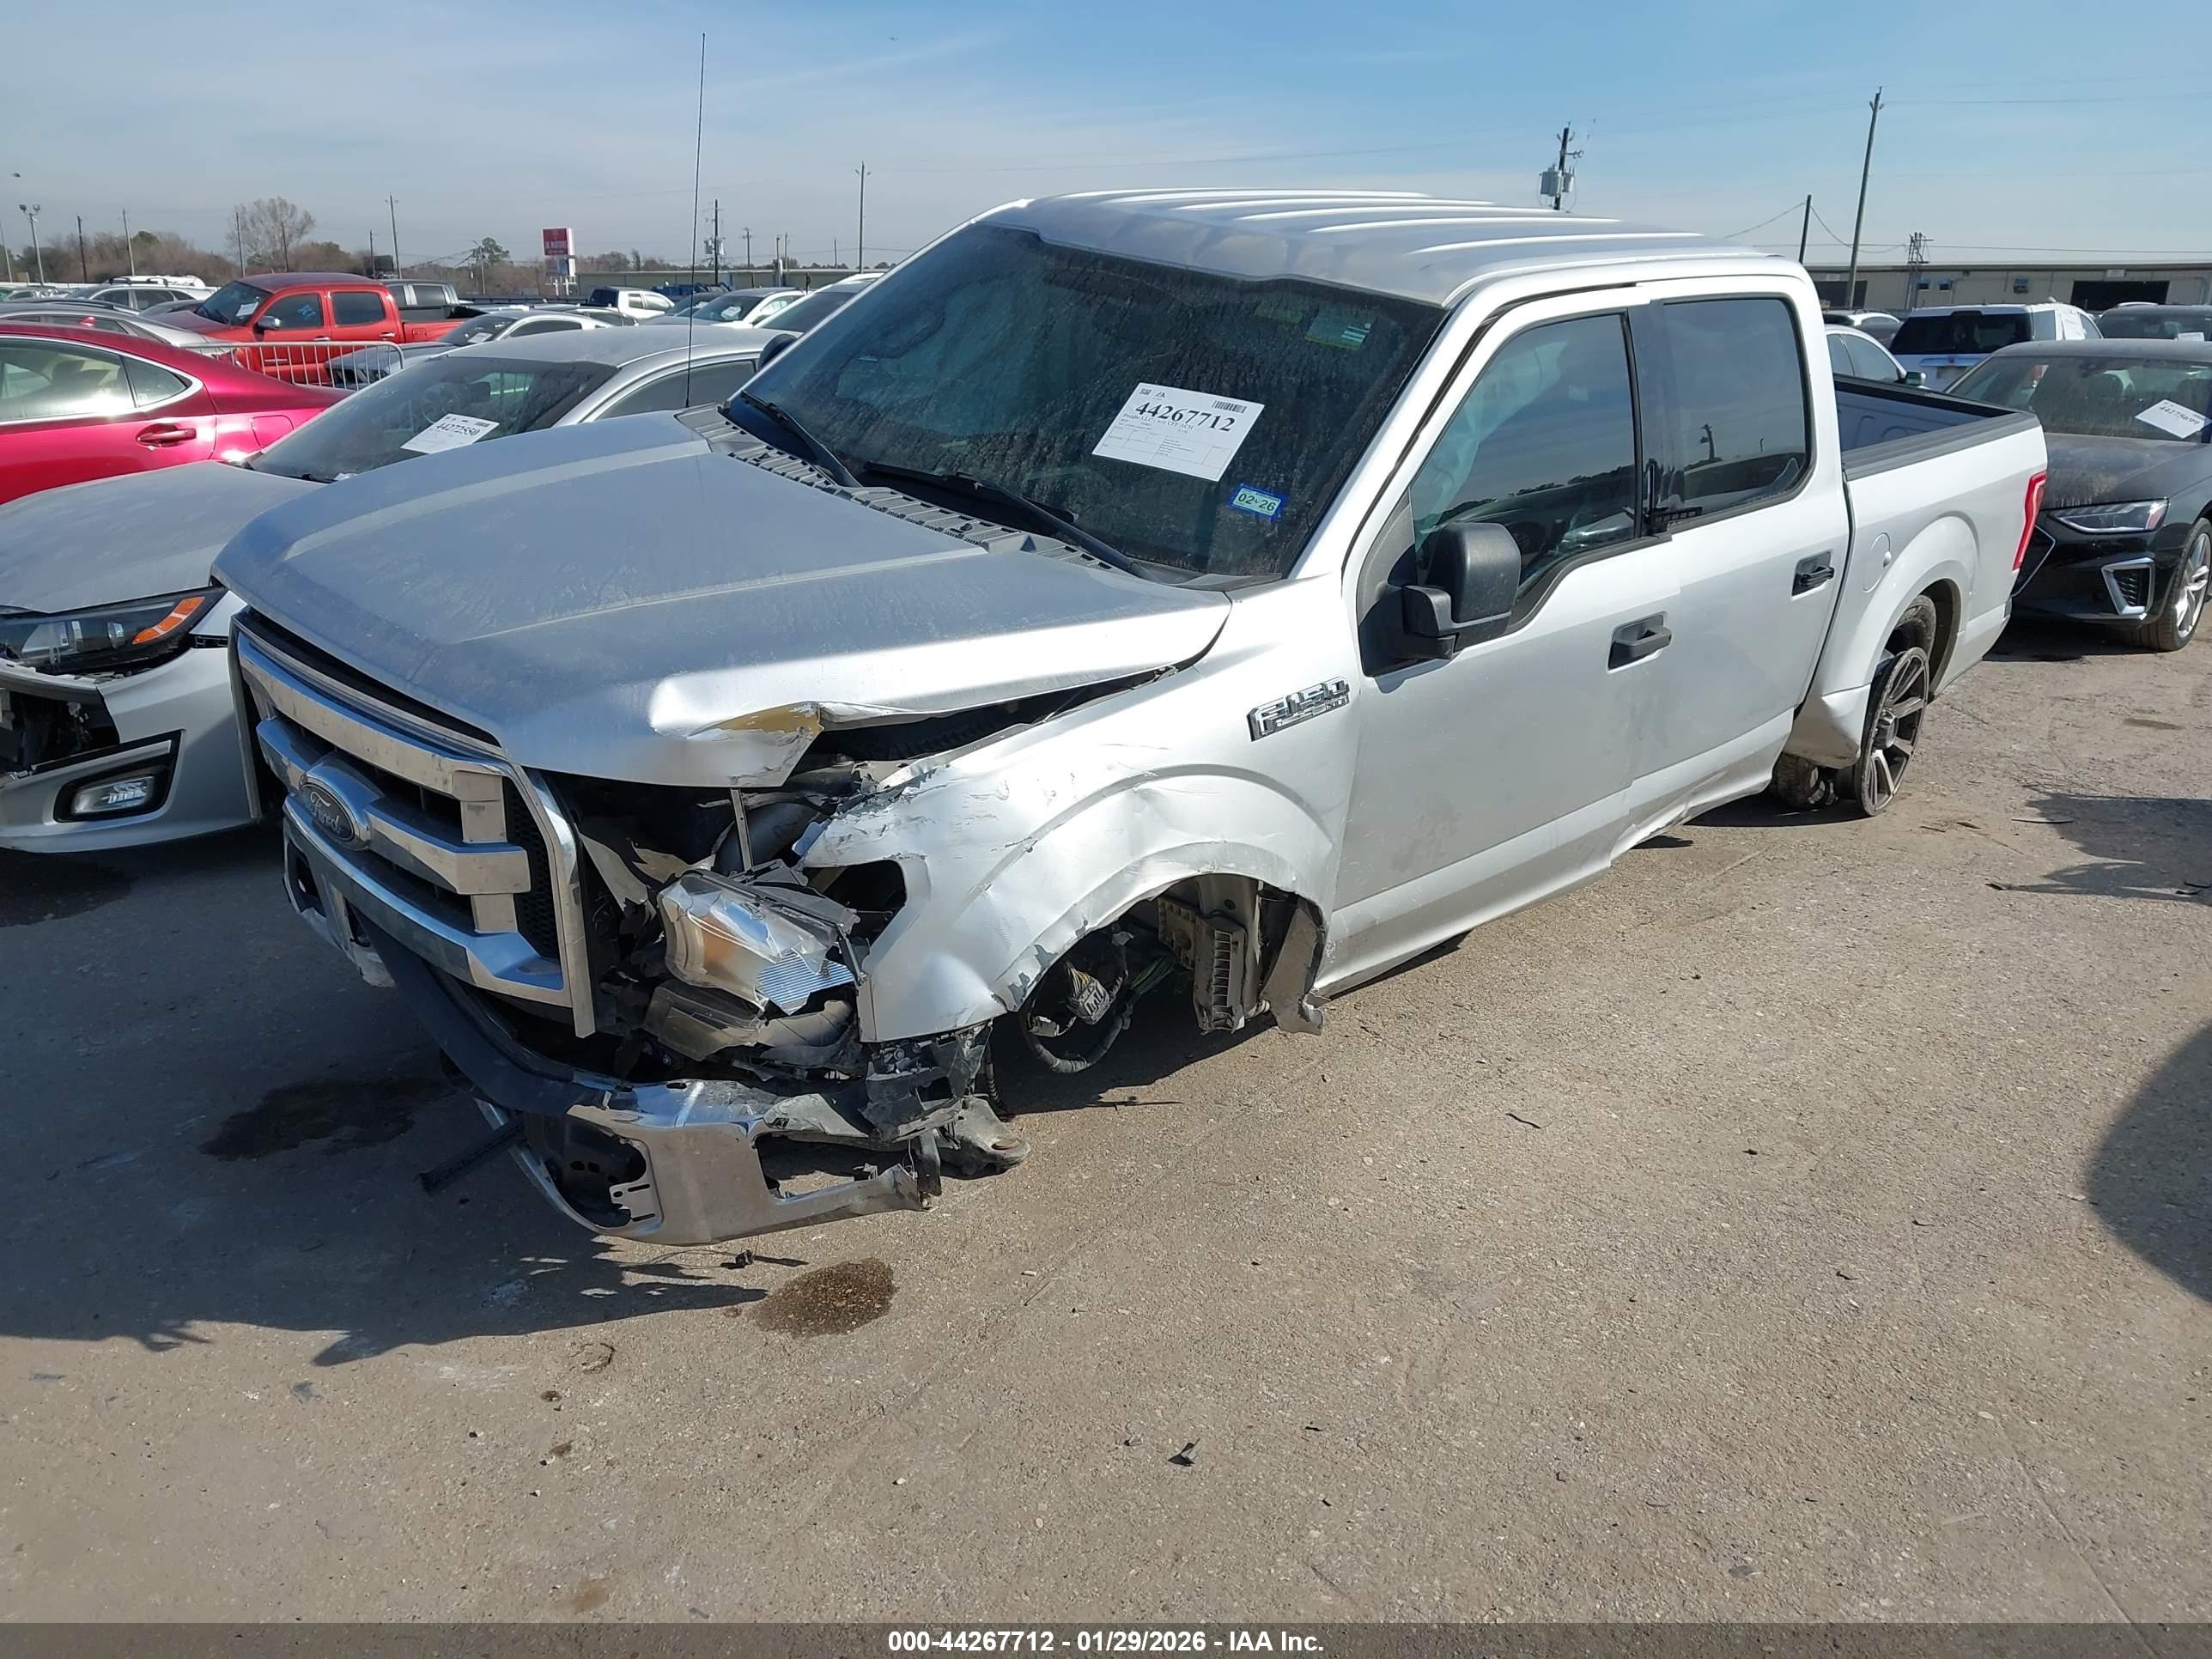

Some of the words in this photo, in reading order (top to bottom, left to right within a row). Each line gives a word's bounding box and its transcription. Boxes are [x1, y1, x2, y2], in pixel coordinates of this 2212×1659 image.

[1135, 401, 1237, 432] 44267712
[1237, 493, 1255, 505] 02
[1258, 499, 1277, 512] 26
[309, 792, 341, 834] Ford
